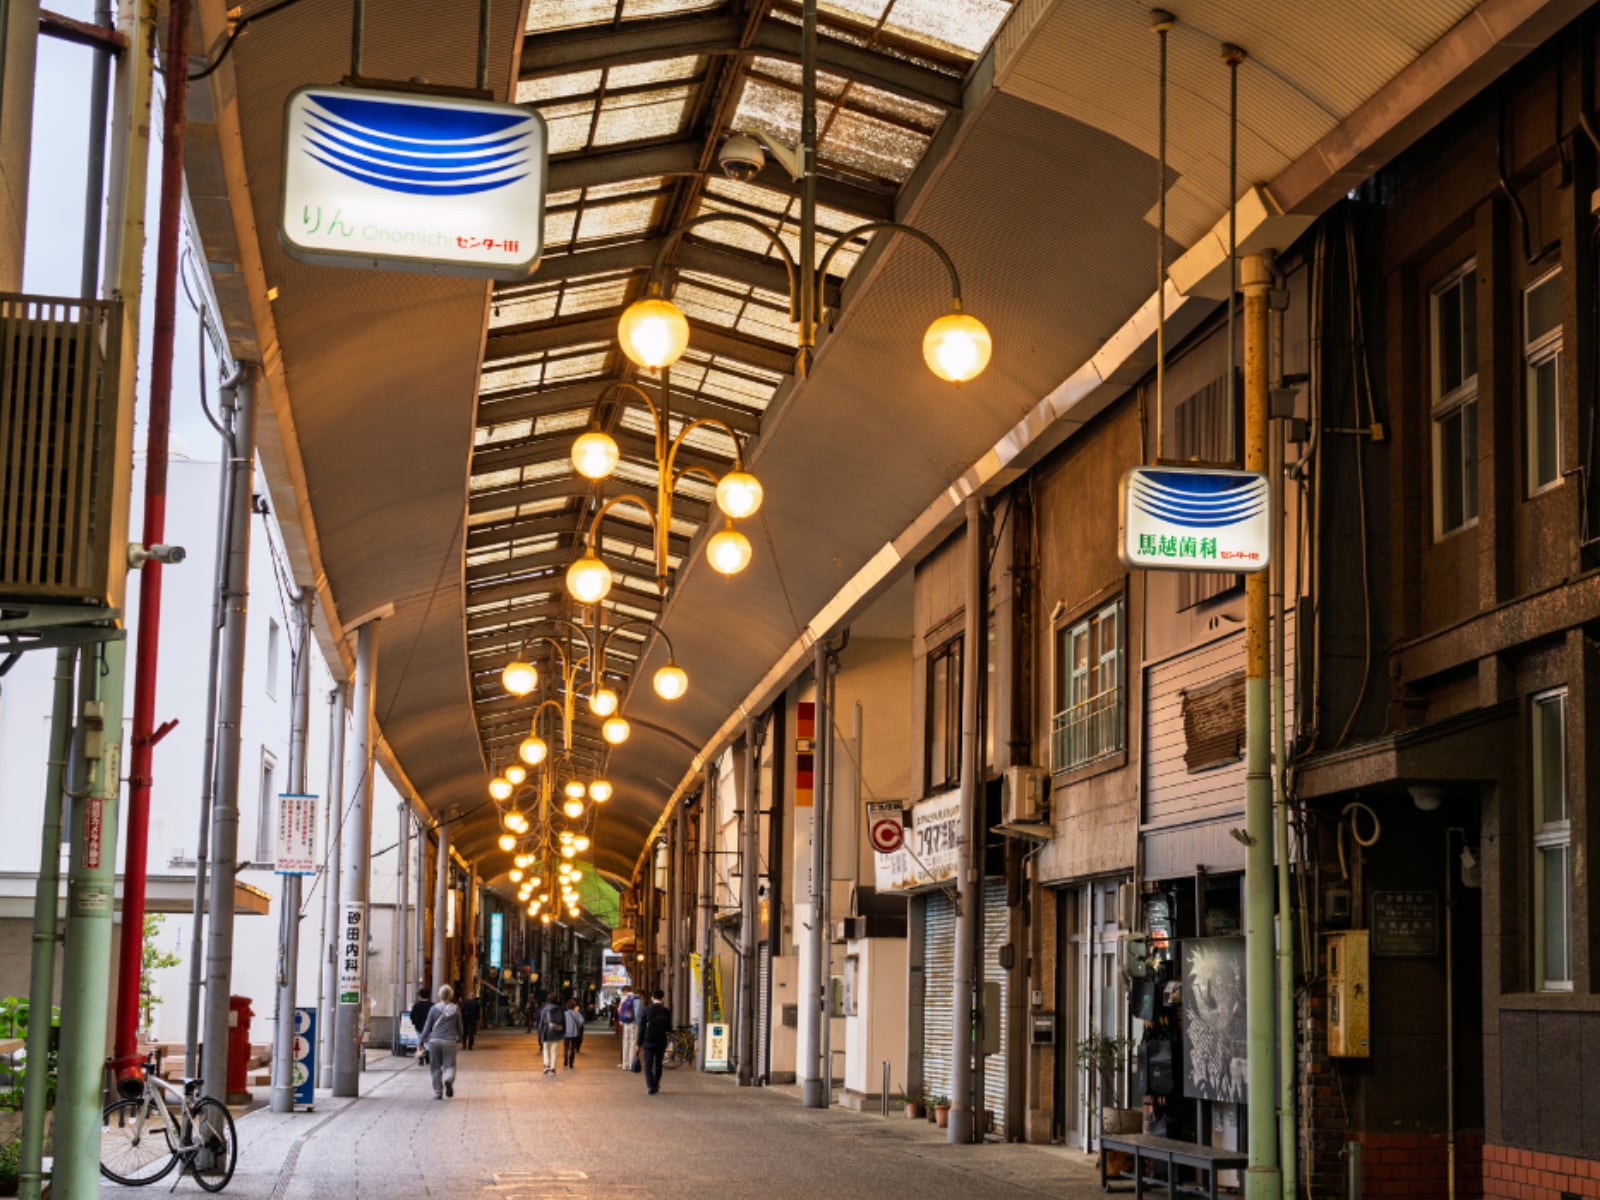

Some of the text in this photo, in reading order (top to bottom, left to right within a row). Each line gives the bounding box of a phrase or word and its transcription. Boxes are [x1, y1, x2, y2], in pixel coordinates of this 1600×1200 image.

[303, 204, 354, 238] りん
[362, 224, 454, 248] Onomichi
[1136, 532, 1217, 559] 馬越歯科
[344, 911, 361, 972] 砂田内科
